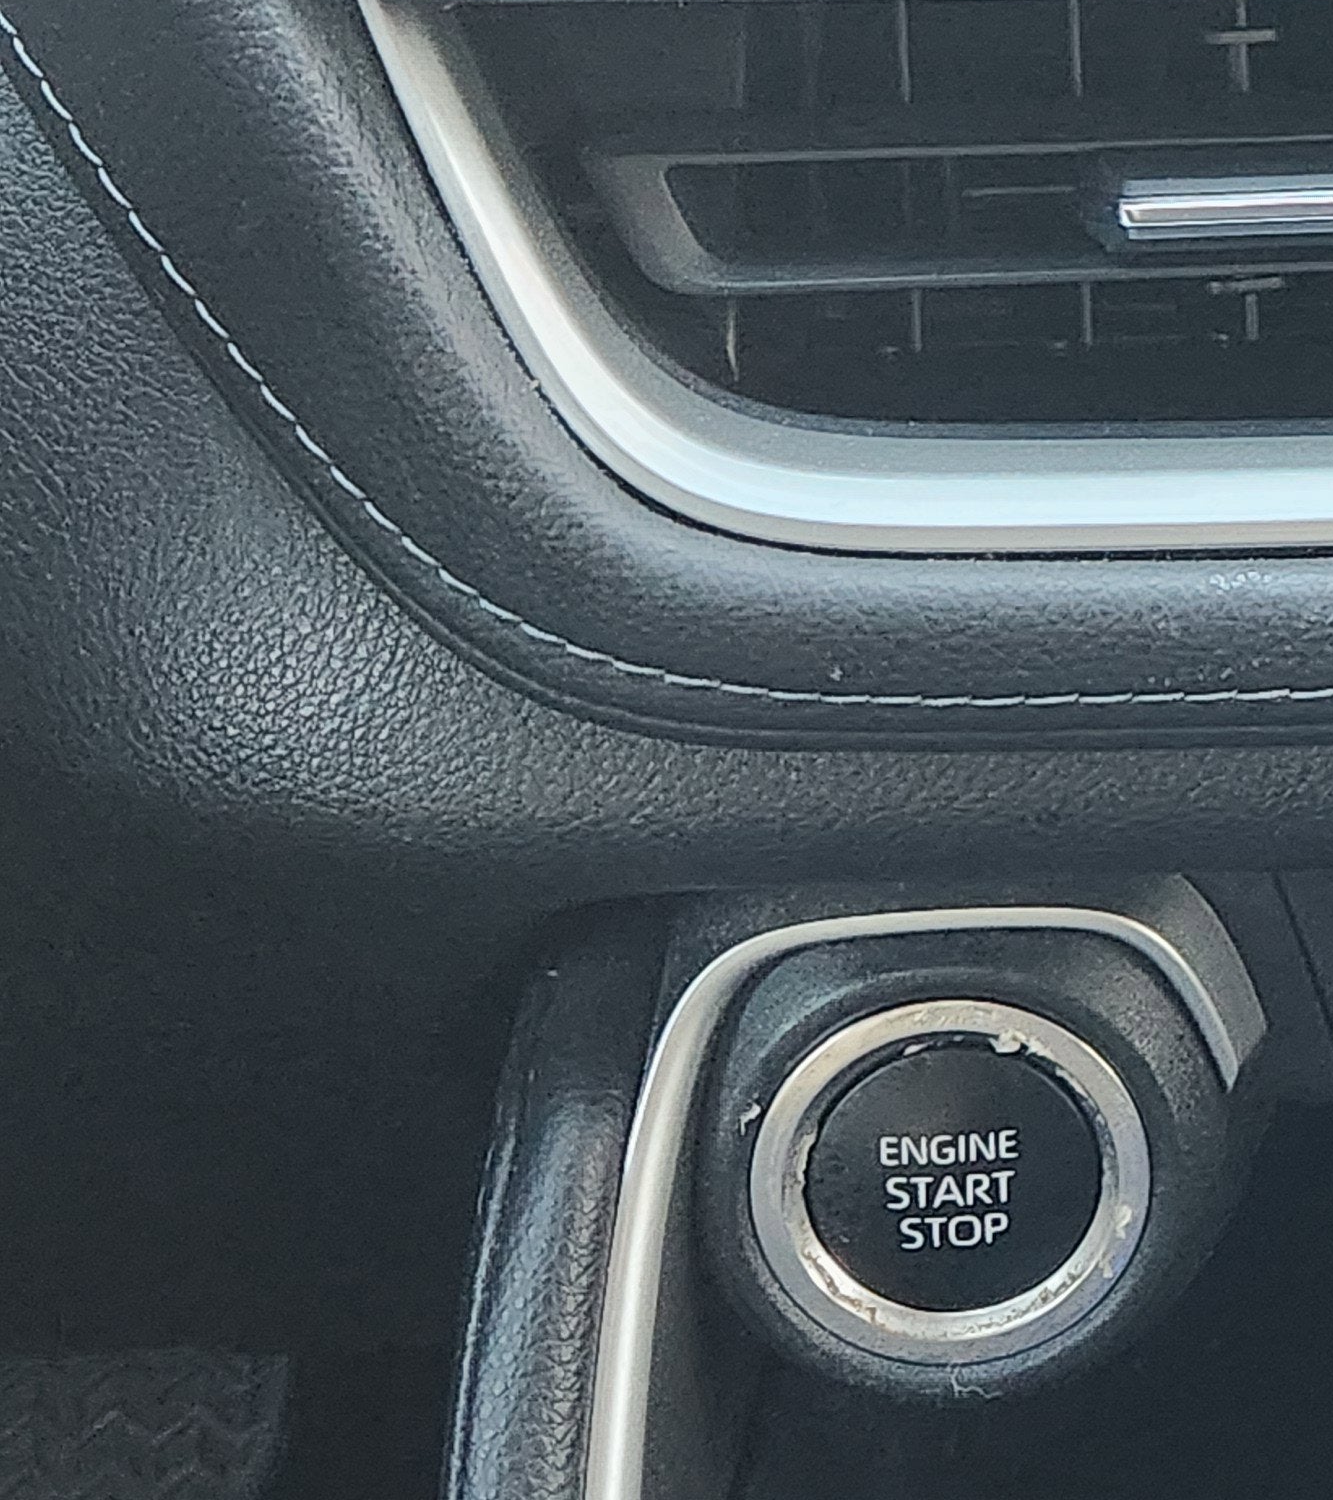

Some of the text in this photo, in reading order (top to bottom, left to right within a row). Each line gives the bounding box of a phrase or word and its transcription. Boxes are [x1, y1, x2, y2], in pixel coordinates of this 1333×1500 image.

[879, 1129, 1020, 1167] ENGINE
[885, 1170, 1015, 1210] START
[899, 1212, 1009, 1250] STOP
